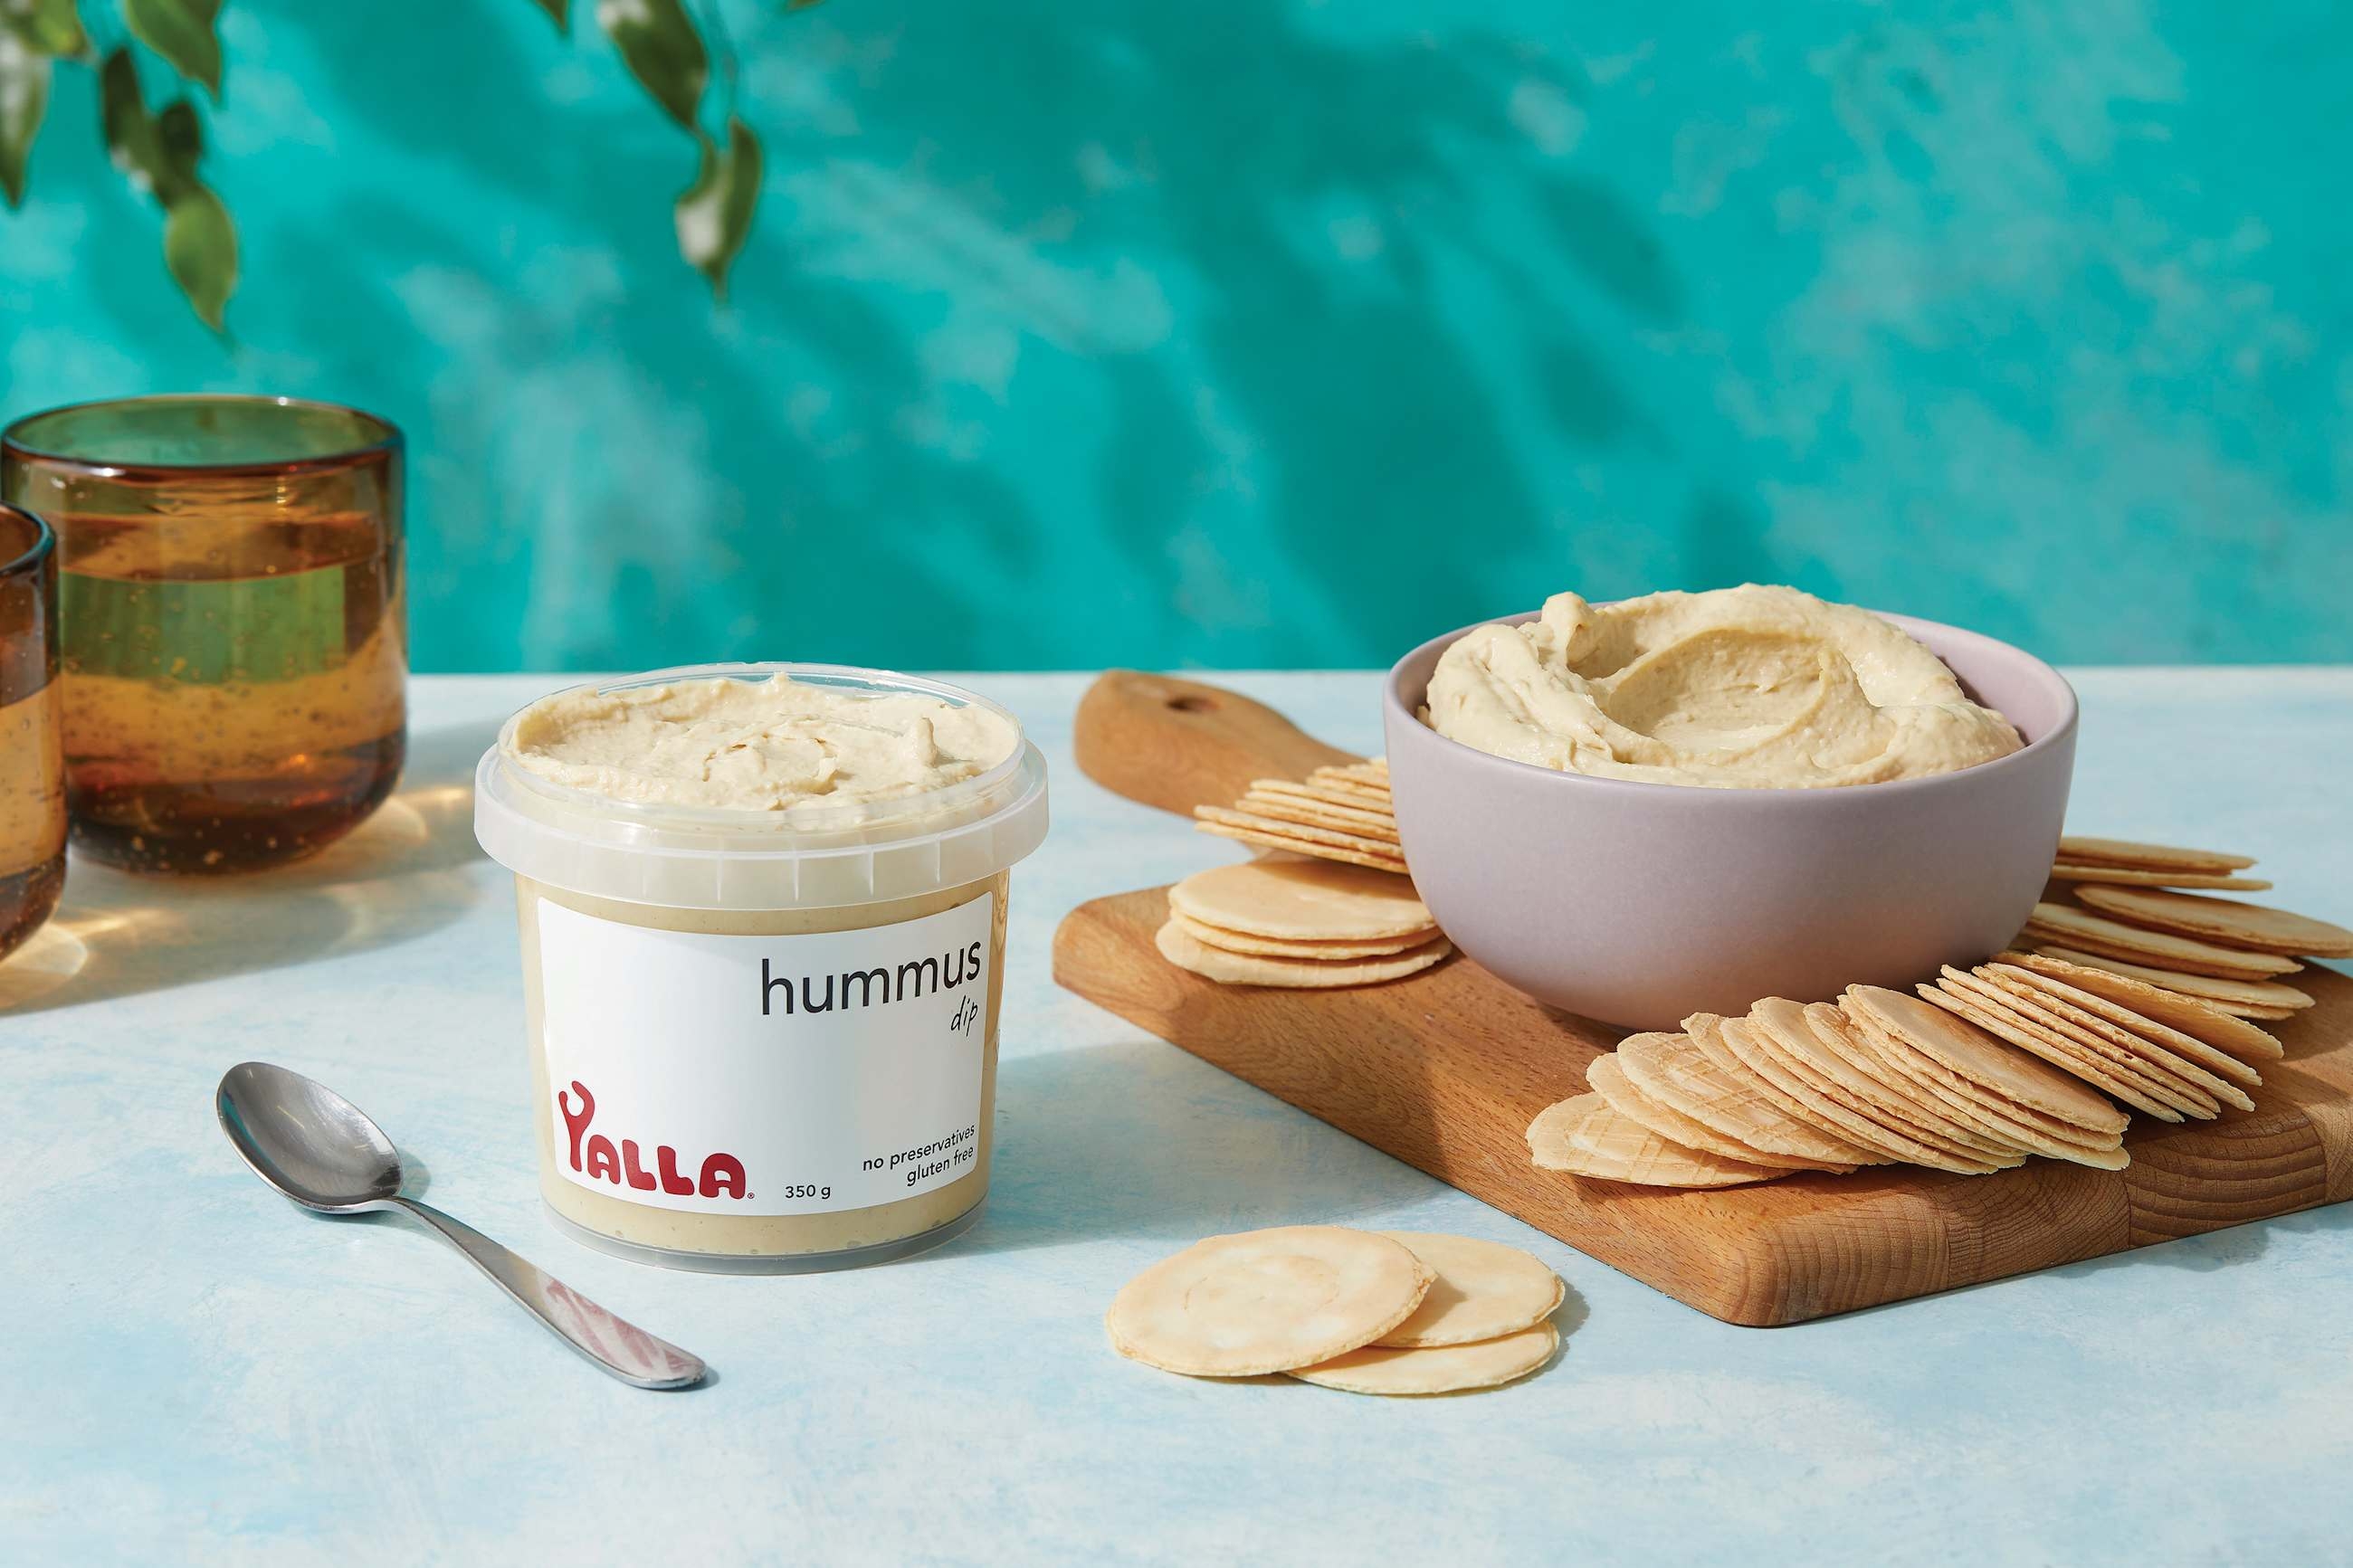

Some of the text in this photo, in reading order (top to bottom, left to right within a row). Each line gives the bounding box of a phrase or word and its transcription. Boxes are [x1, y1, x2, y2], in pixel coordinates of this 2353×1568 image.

[761, 941, 982, 1016] hummus
[950, 994, 978, 1038] dip
[862, 1124, 975, 1172] no preservatives
[907, 1145, 974, 1187] gluten free
[785, 1183, 831, 1201] 350 g
